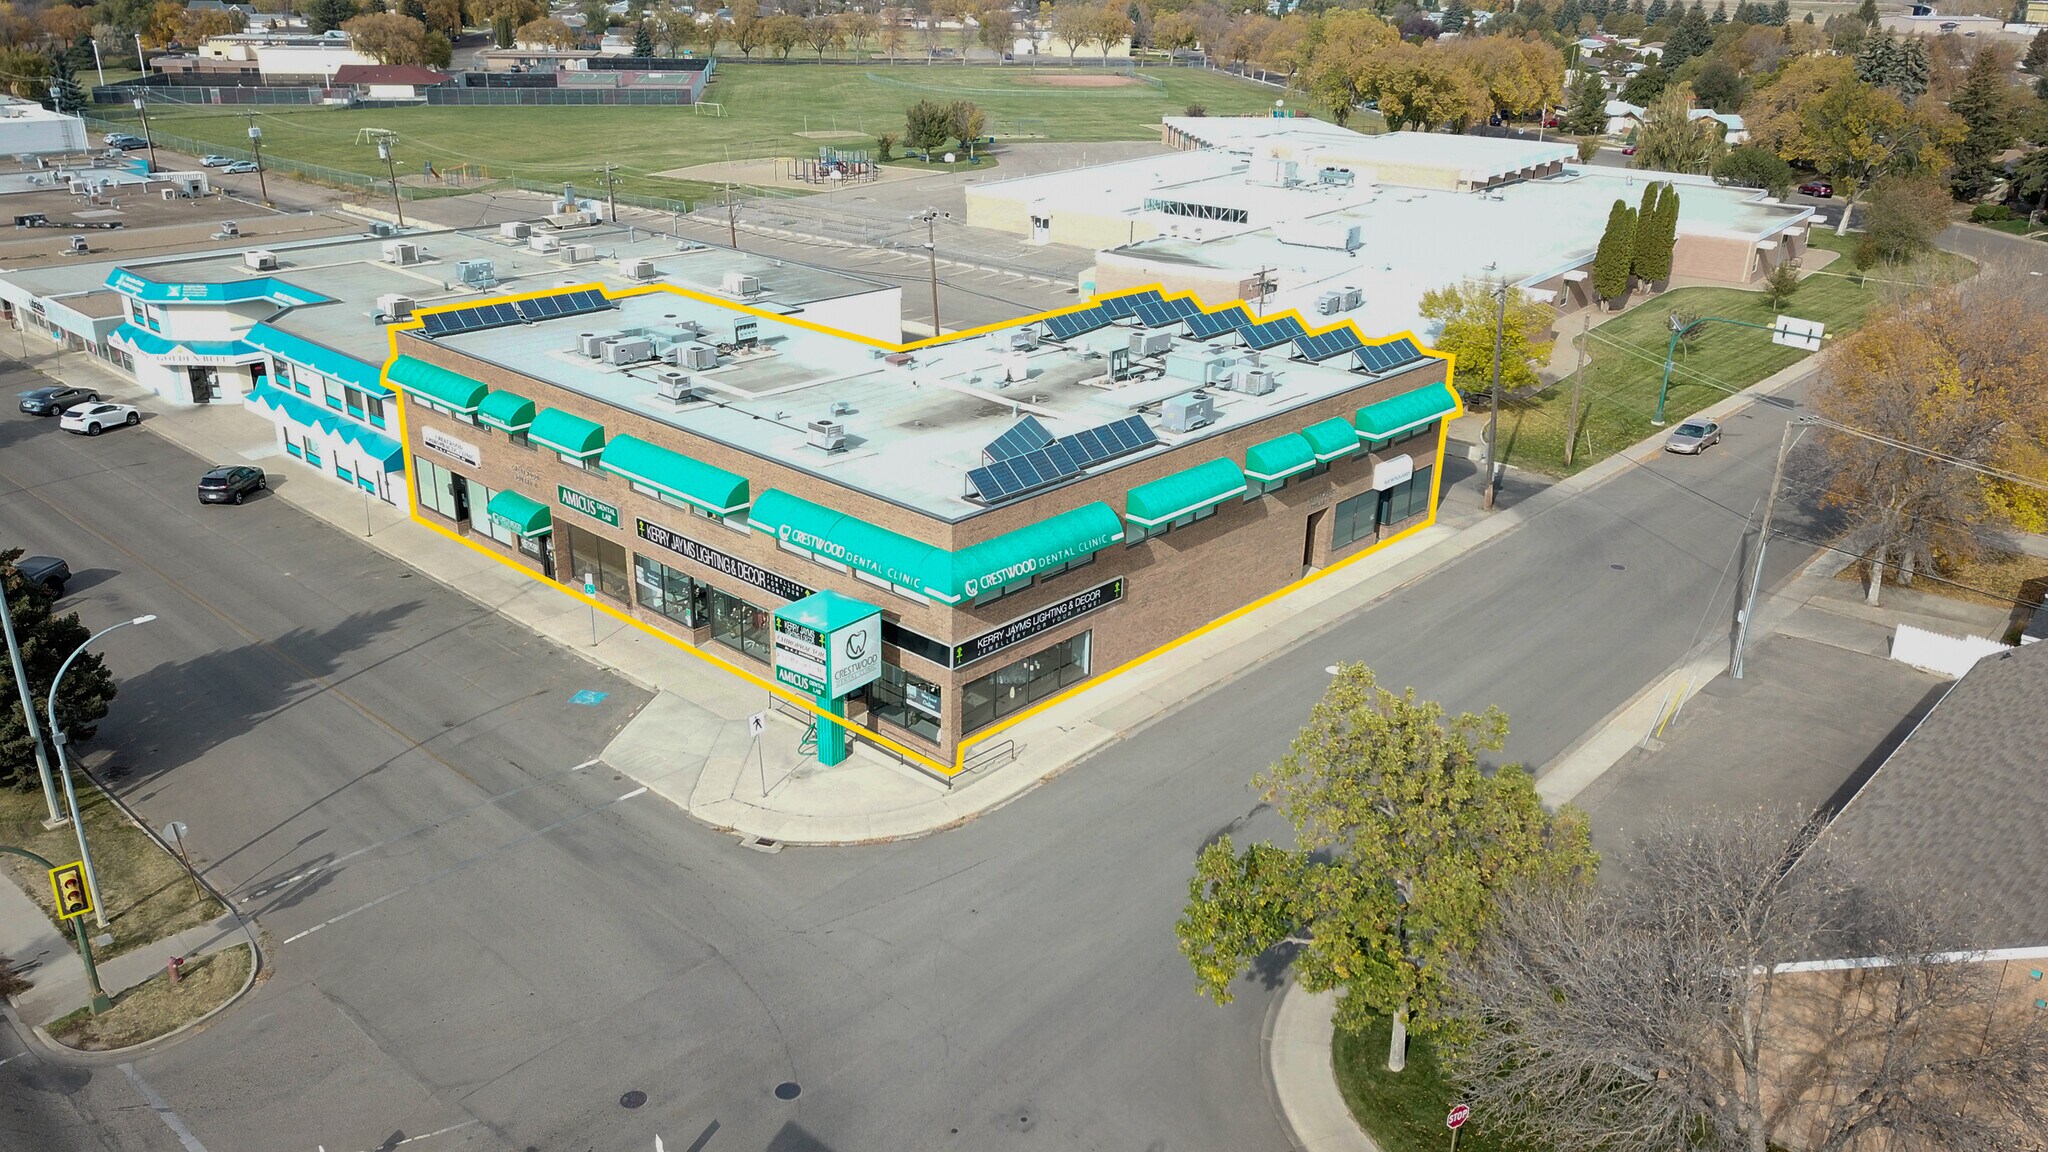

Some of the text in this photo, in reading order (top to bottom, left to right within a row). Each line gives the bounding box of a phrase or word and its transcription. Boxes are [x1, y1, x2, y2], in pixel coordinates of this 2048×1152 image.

[562, 489, 616, 516] AMICUS DENTAL
[601, 512, 612, 522] LAB
[646, 524, 766, 588] KERRY JAYMS LIGHTING & DECOR
[791, 529, 920, 589] CRESTWOOD DENTAL CLINIC
[980, 534, 1108, 589] CRESTWOOD DENTAL CLINIC
[977, 589, 1101, 649] KERRY JAYMS LIGHTING & DECOR
[977, 599, 1101, 656] JEWELLERY FOR YOUR HOME!
[779, 668, 809, 690] AMICUS
[835, 654, 878, 680] CRESTWOOD
[1448, 1109, 1468, 1124] STOP
